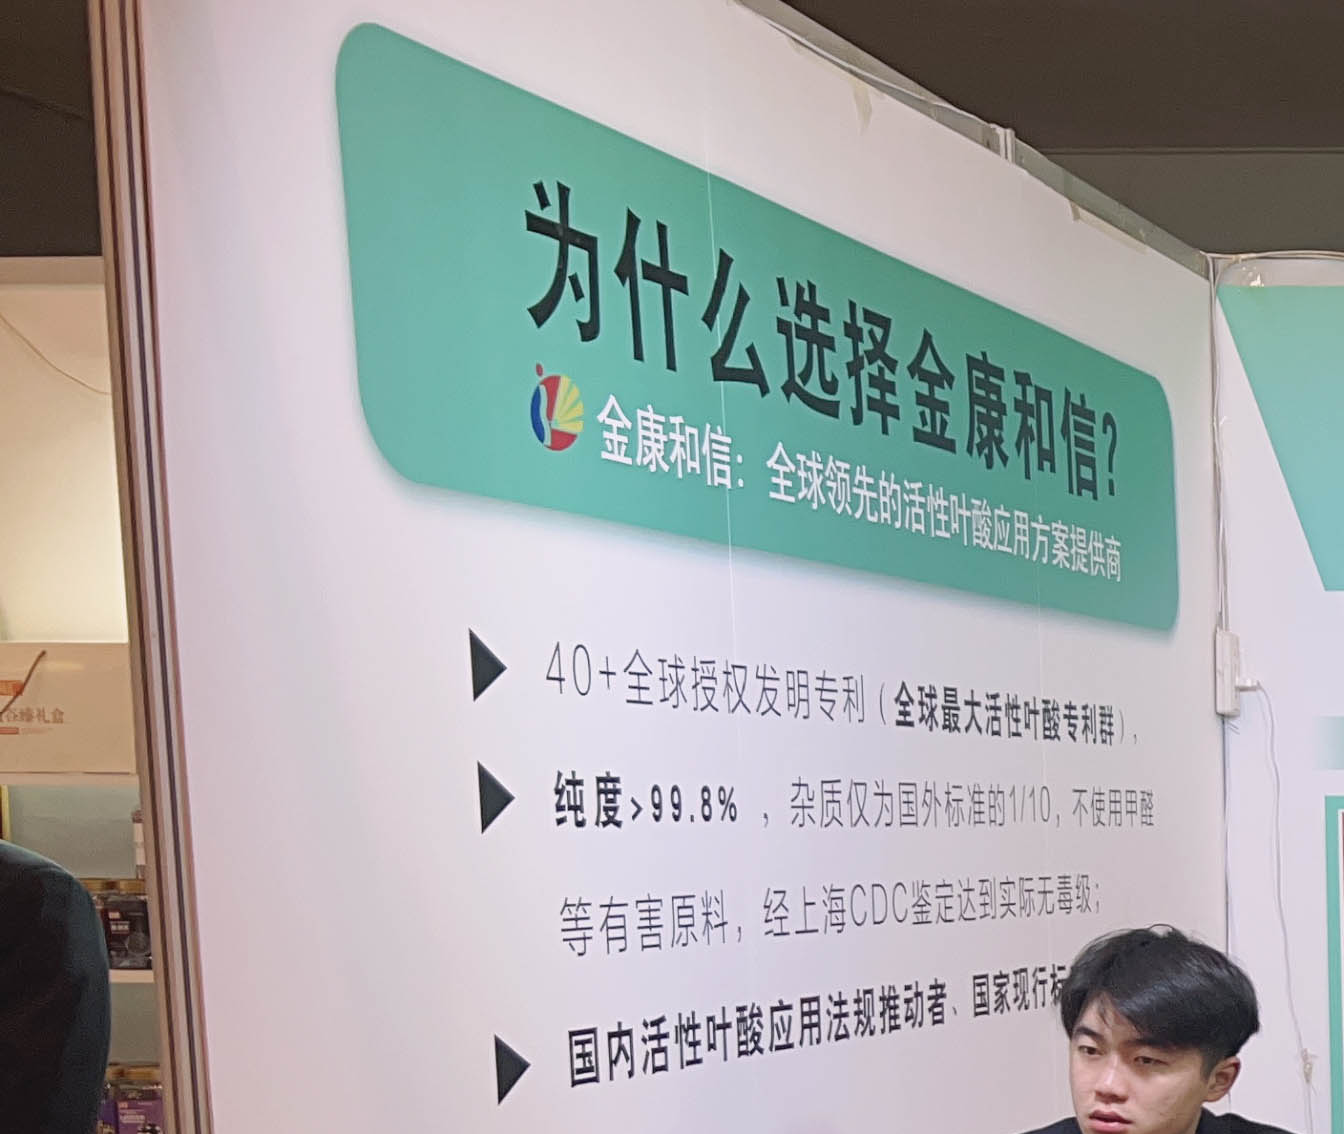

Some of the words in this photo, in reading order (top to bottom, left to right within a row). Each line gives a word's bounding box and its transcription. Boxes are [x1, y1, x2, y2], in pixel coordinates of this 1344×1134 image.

[525, 179, 1118, 502] 为什么选择金康和信？
